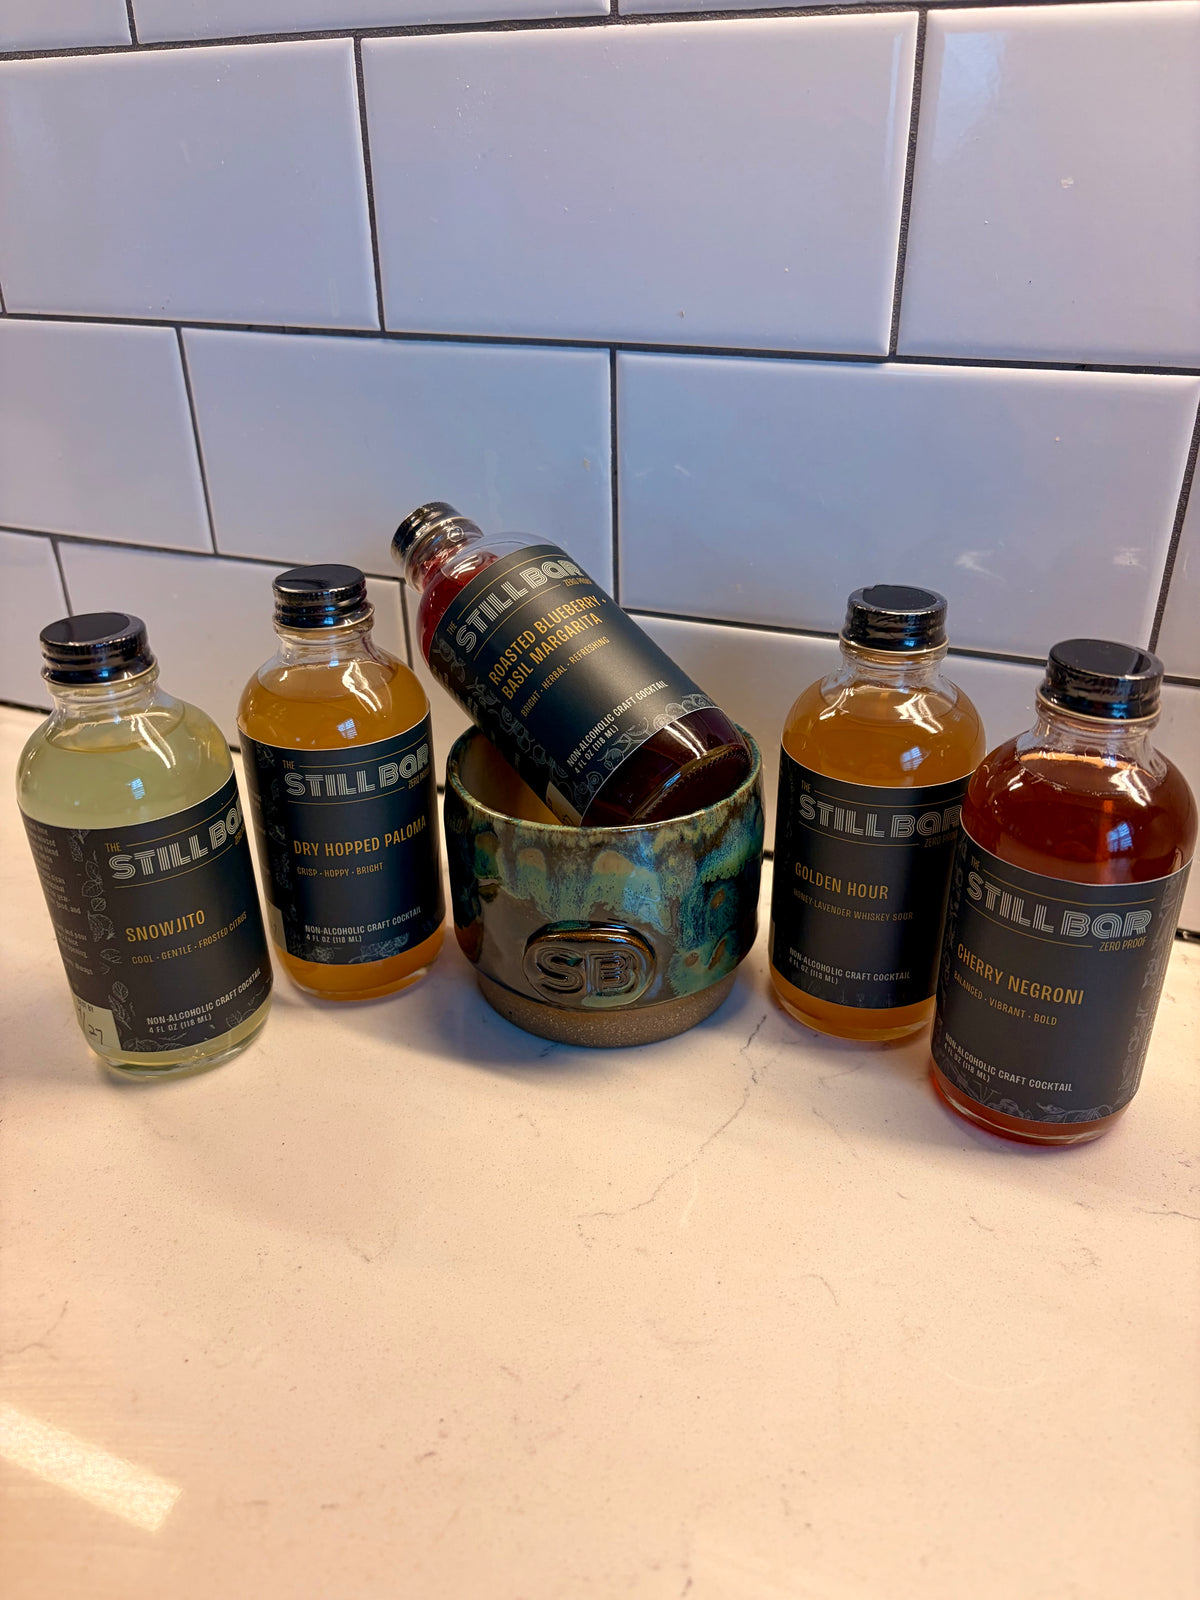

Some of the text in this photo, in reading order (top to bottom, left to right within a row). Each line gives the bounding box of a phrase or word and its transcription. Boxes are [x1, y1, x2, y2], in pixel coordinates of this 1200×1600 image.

[446, 621, 458, 635] THE
[455, 581, 528, 653] STILL
[488, 595, 601, 685] ROASTED BLUEBERRY
[501, 612, 603, 700] BASIL MARGARITA
[520, 636, 610, 717] BRIGHT HERBAL REFRESHING
[566, 679, 669, 768] NON-ALCOHOLIC CRAFT COCKTAIL
[282, 759, 295, 770] THE
[573, 724, 619, 775] 4 FL OZ (118 ML)
[284, 770, 376, 797] STILL
[801, 780, 812, 793] THE
[293, 815, 426, 857] DRY HOPPED PALOMA
[799, 794, 886, 838] STILL
[104, 842, 122, 853] THE
[108, 834, 209, 880] STILL
[970, 855, 981, 872] THE
[296, 862, 384, 878] CRISP HOPPY BRIGHT
[795, 862, 889, 900] GOLDEN HOUR
[304, 906, 422, 936] NON-ALCOHOLIC CRAFT COCKTAIL
[793, 888, 914, 922] HONEY-LAVENDER WHISKEY SOUR
[966, 871, 1055, 934] STILL
[125, 910, 205, 942] SNOWJITO
[131, 911, 247, 965] COOL GENTLE FROSTED CITRUS
[305, 933, 311, 941] 4
[311, 934, 321, 942] FL
[1099, 937, 1147, 952] ZERO PROOF
[534, 946, 641, 998] SB
[789, 946, 911, 981] NON-ALCOHOLIC CRAFT COCKTAIL
[793, 959, 801, 969] FL
[801, 963, 809, 973] OZ
[810, 967, 823, 981] (118
[824, 973, 838, 985] ML)
[957, 943, 1084, 1006] CHERRY NEGRONI
[146, 967, 261, 1025] NON-ALCOHOLIC CRAFT COCKTAIL
[953, 970, 1058, 1026] BALANCED VIBRANT BOLD
[148, 1013, 212, 1034] 4 FL OZ (118 ML)
[943, 1042, 991, 1084] 4 FL OZ (118 ML)
[944, 1031, 1073, 1093] NON-ALCOHOLIC CRAFT COCKTAIL
